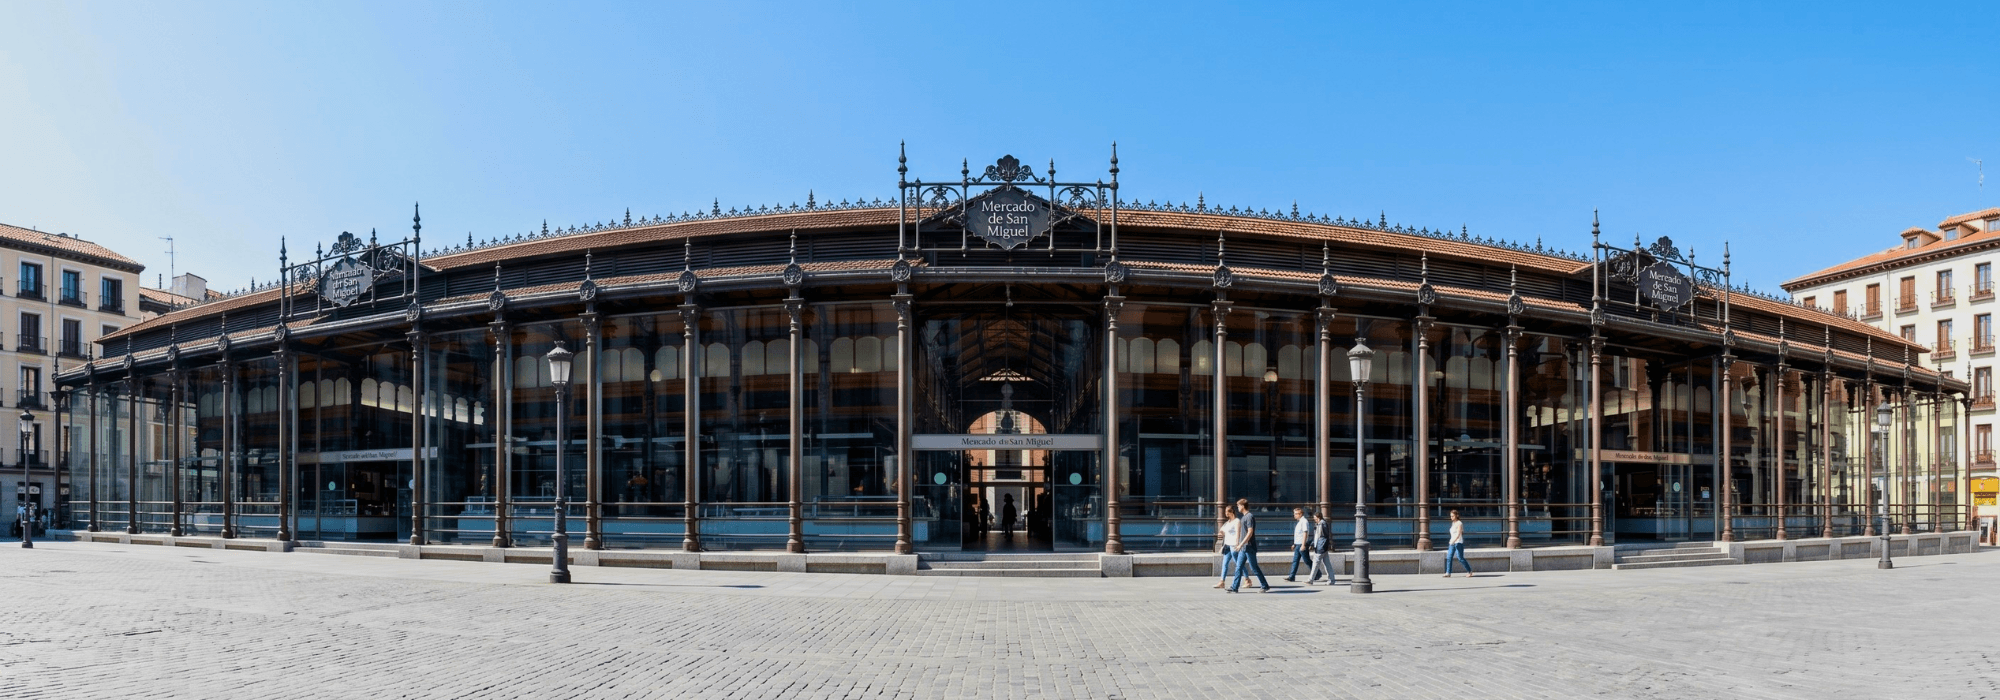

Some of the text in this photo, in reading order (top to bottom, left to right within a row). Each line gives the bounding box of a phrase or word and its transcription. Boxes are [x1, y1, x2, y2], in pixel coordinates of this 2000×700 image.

[982, 200, 1035, 212] Mercado
[988, 212, 1028, 224] de San
[344, 278, 359, 288] San
[1649, 270, 1682, 285] Mercado
[1652, 280, 1677, 293] de San
[1025, 438, 1053, 447] Miguel
